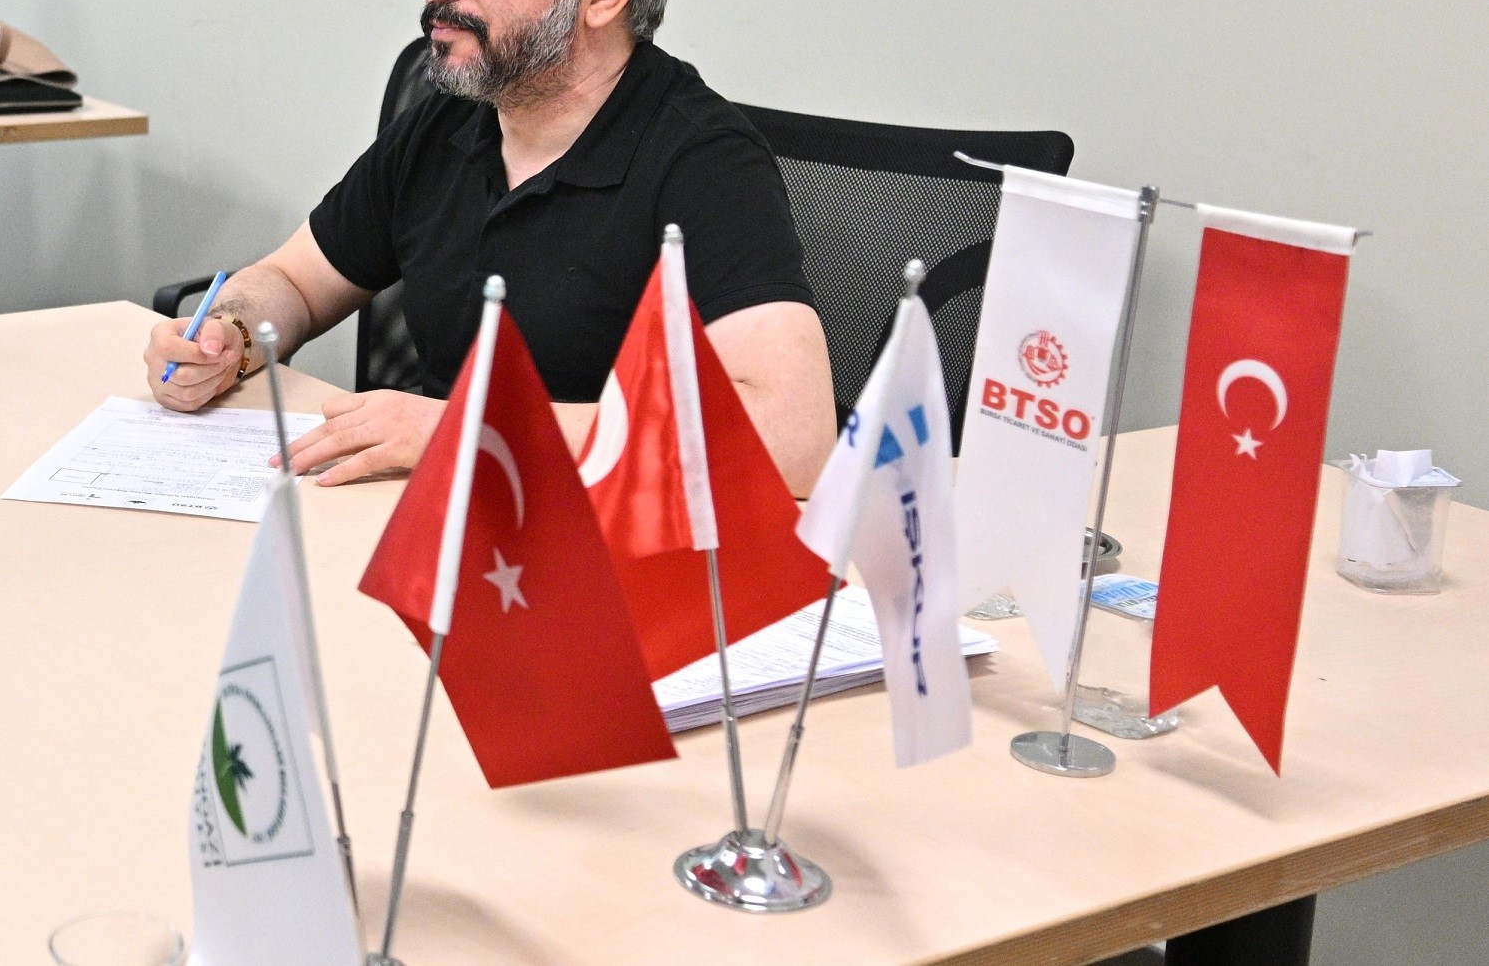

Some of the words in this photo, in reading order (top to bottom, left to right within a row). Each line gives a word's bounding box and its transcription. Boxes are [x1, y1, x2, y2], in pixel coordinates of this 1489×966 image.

[980, 408, 1001, 420] BURSA
[1031, 426, 1040, 435] VE
[982, 378, 1091, 439] BTSO
